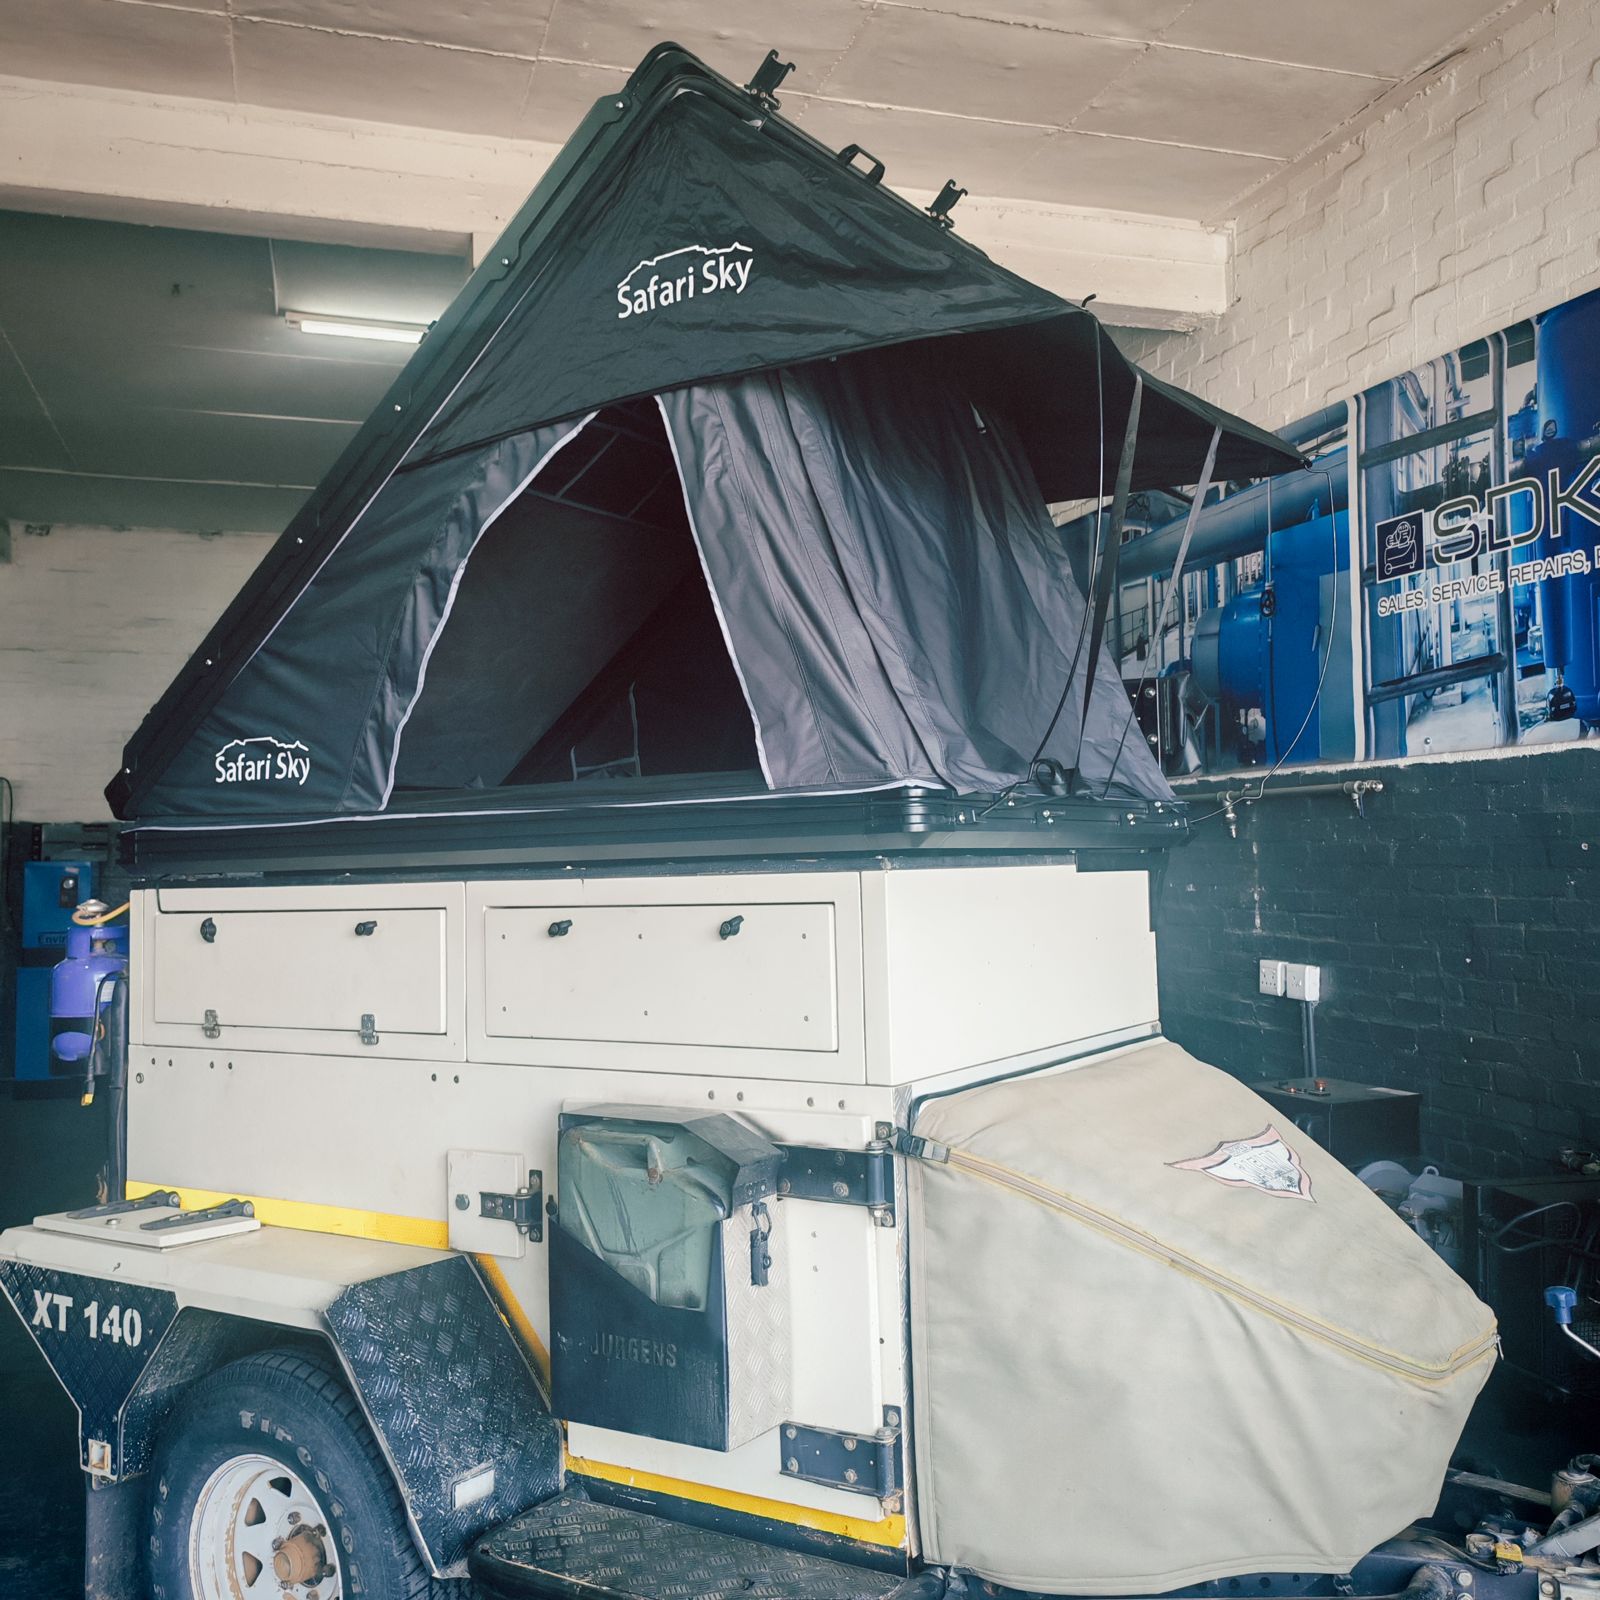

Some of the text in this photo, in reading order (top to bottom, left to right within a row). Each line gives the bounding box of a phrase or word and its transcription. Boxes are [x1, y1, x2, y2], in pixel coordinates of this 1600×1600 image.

[617, 256, 754, 319] Safari Sky
[1378, 591, 1427, 616] SALES,
[1432, 571, 1504, 604] SERVICE,
[1508, 551, 1590, 586] REPAIRS,
[215, 751, 310, 785] Safari Sky
[32, 1289, 142, 1347] XT 140
